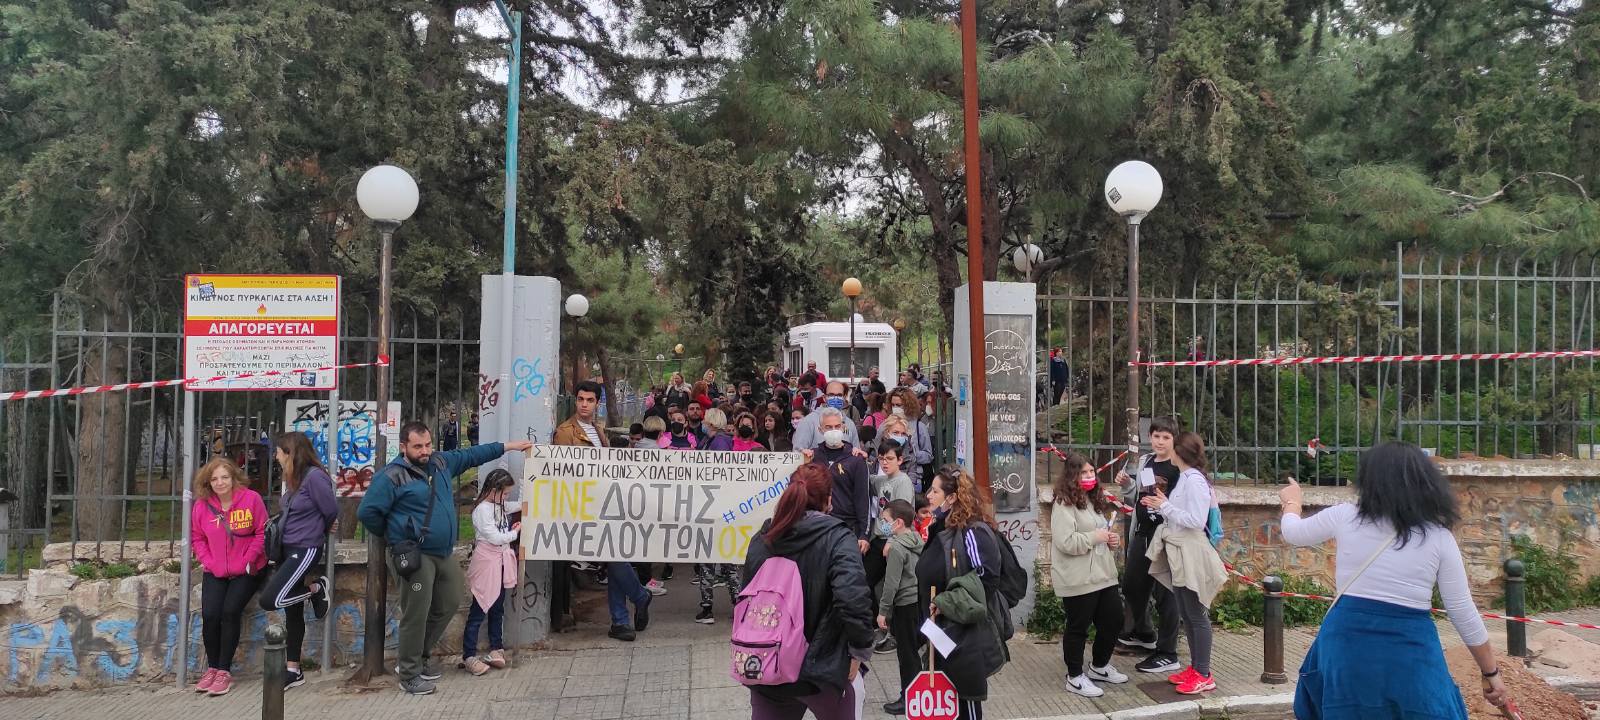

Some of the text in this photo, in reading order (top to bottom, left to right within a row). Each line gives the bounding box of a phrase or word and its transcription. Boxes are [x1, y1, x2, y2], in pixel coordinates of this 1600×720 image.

[237, 294, 285, 302] ΠΥΡΚΑΓΙΑΣ
[287, 294, 302, 302] ΣΤΑ
[304, 294, 329, 302] ΑΛΣΗ
[208, 322, 315, 335] ΑΠΑΓΟΡΕΥΕΤΑΙ
[533, 444, 602, 461] ΣΥΛΛΟΓΟΙ
[607, 447, 660, 463] ΓΟΝΕΩΝ
[681, 451, 754, 465] ΚΗΔΕΜΟΝΩΝ
[695, 466, 779, 483] ΚΕΡΑΤΣΙΝΙΟΥ
[599, 482, 722, 525] ΔΟΤΗΣ
[531, 521, 753, 561] ΜΥΕΛΟΥ ΤΩΝ ΟΣ
[909, 689, 956, 717] STOP
